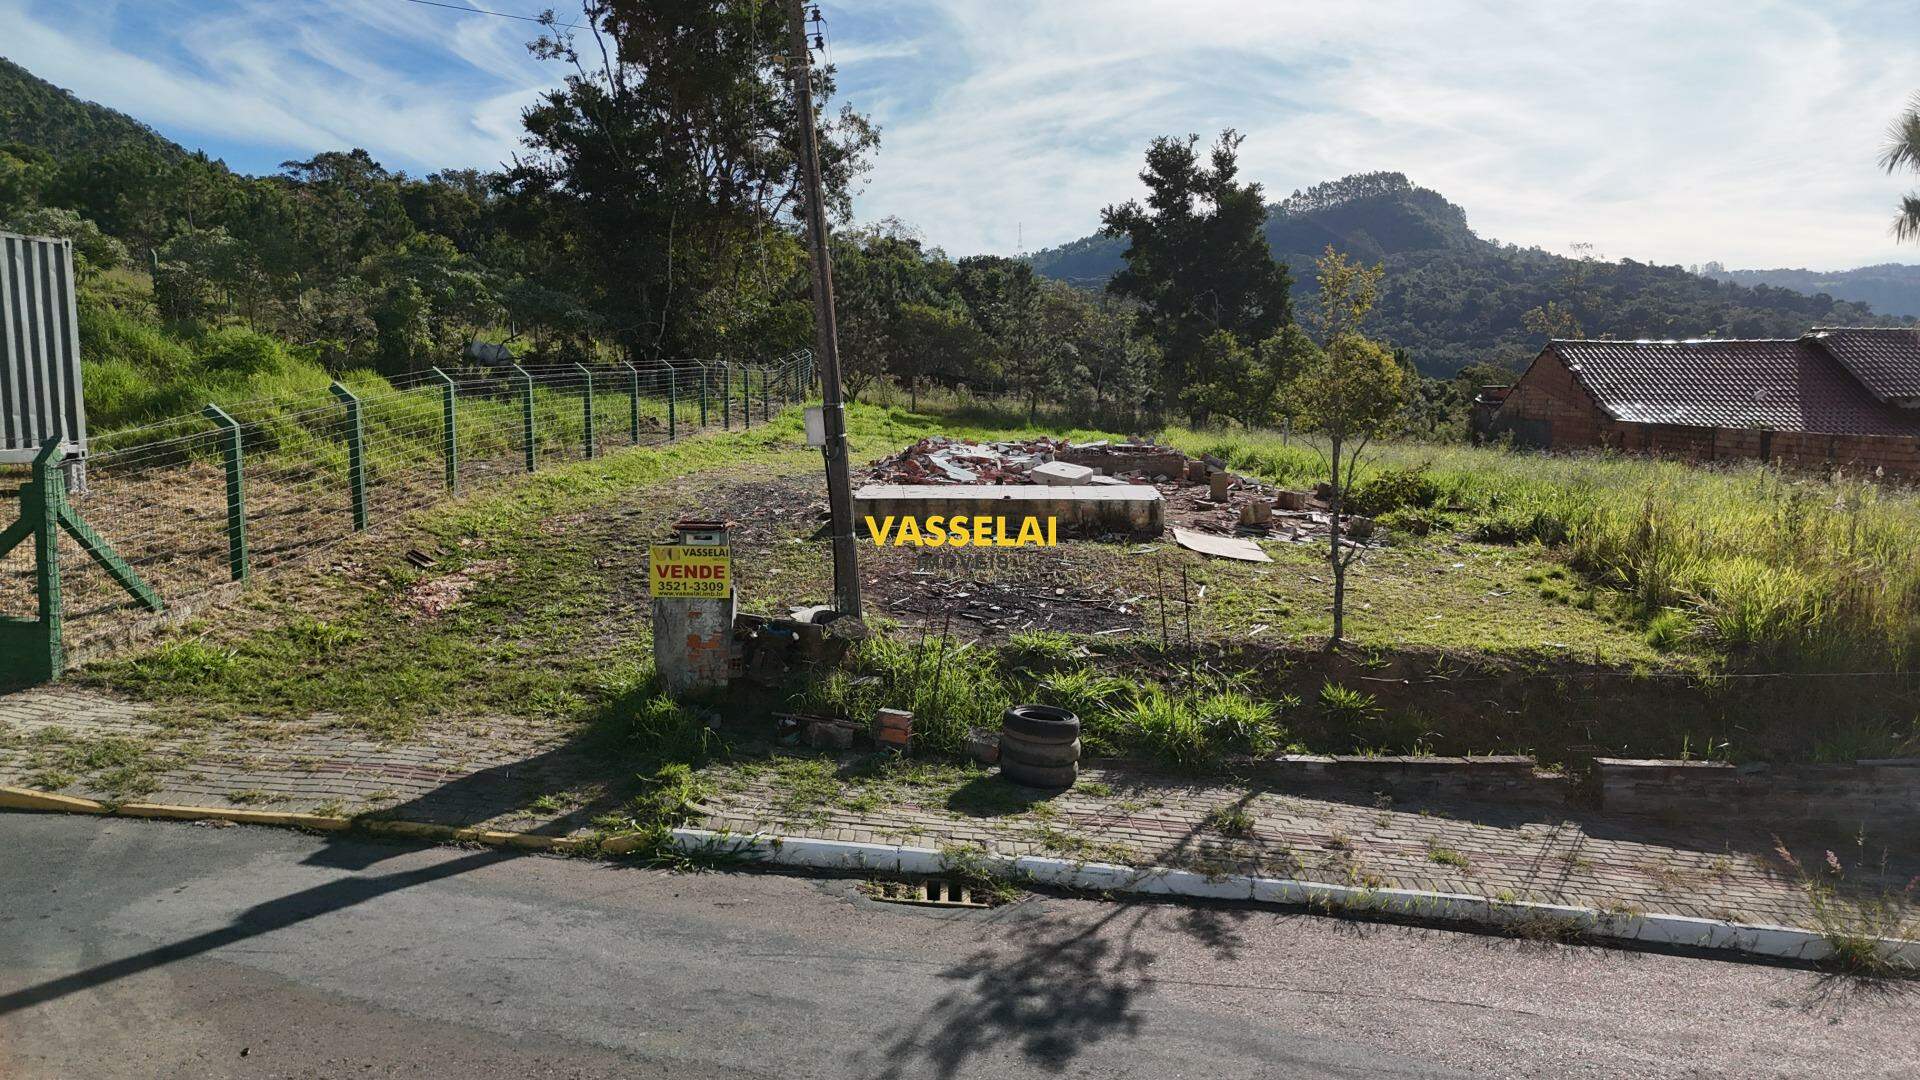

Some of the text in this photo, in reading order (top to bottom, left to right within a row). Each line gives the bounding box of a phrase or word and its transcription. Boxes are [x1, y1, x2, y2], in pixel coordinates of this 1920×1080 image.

[682, 548, 729, 557] VASSELAI
[656, 564, 726, 579] VENDE
[658, 581, 724, 592] 3521-3309
